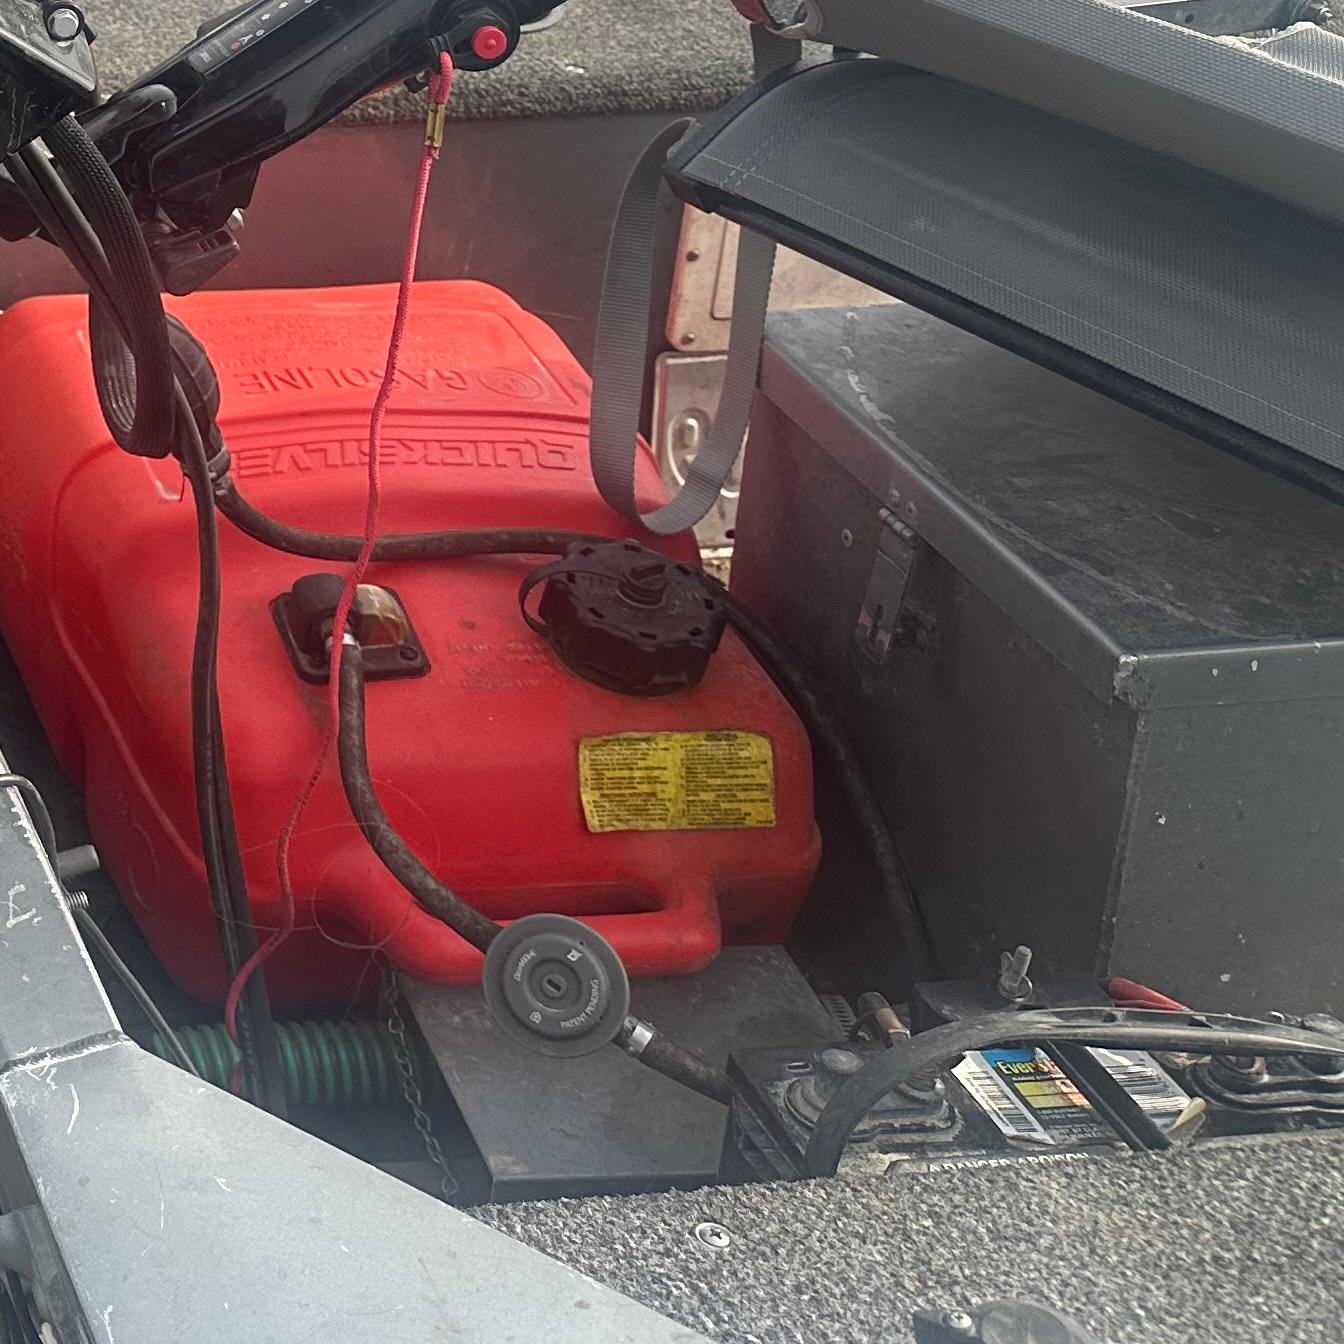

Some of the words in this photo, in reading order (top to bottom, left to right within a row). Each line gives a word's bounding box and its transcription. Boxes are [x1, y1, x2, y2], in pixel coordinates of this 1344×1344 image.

[229, 437, 577, 478] QUICKSILVE
[560, 1009, 587, 1028] PATENT
[585, 979, 600, 1015] PENDING
